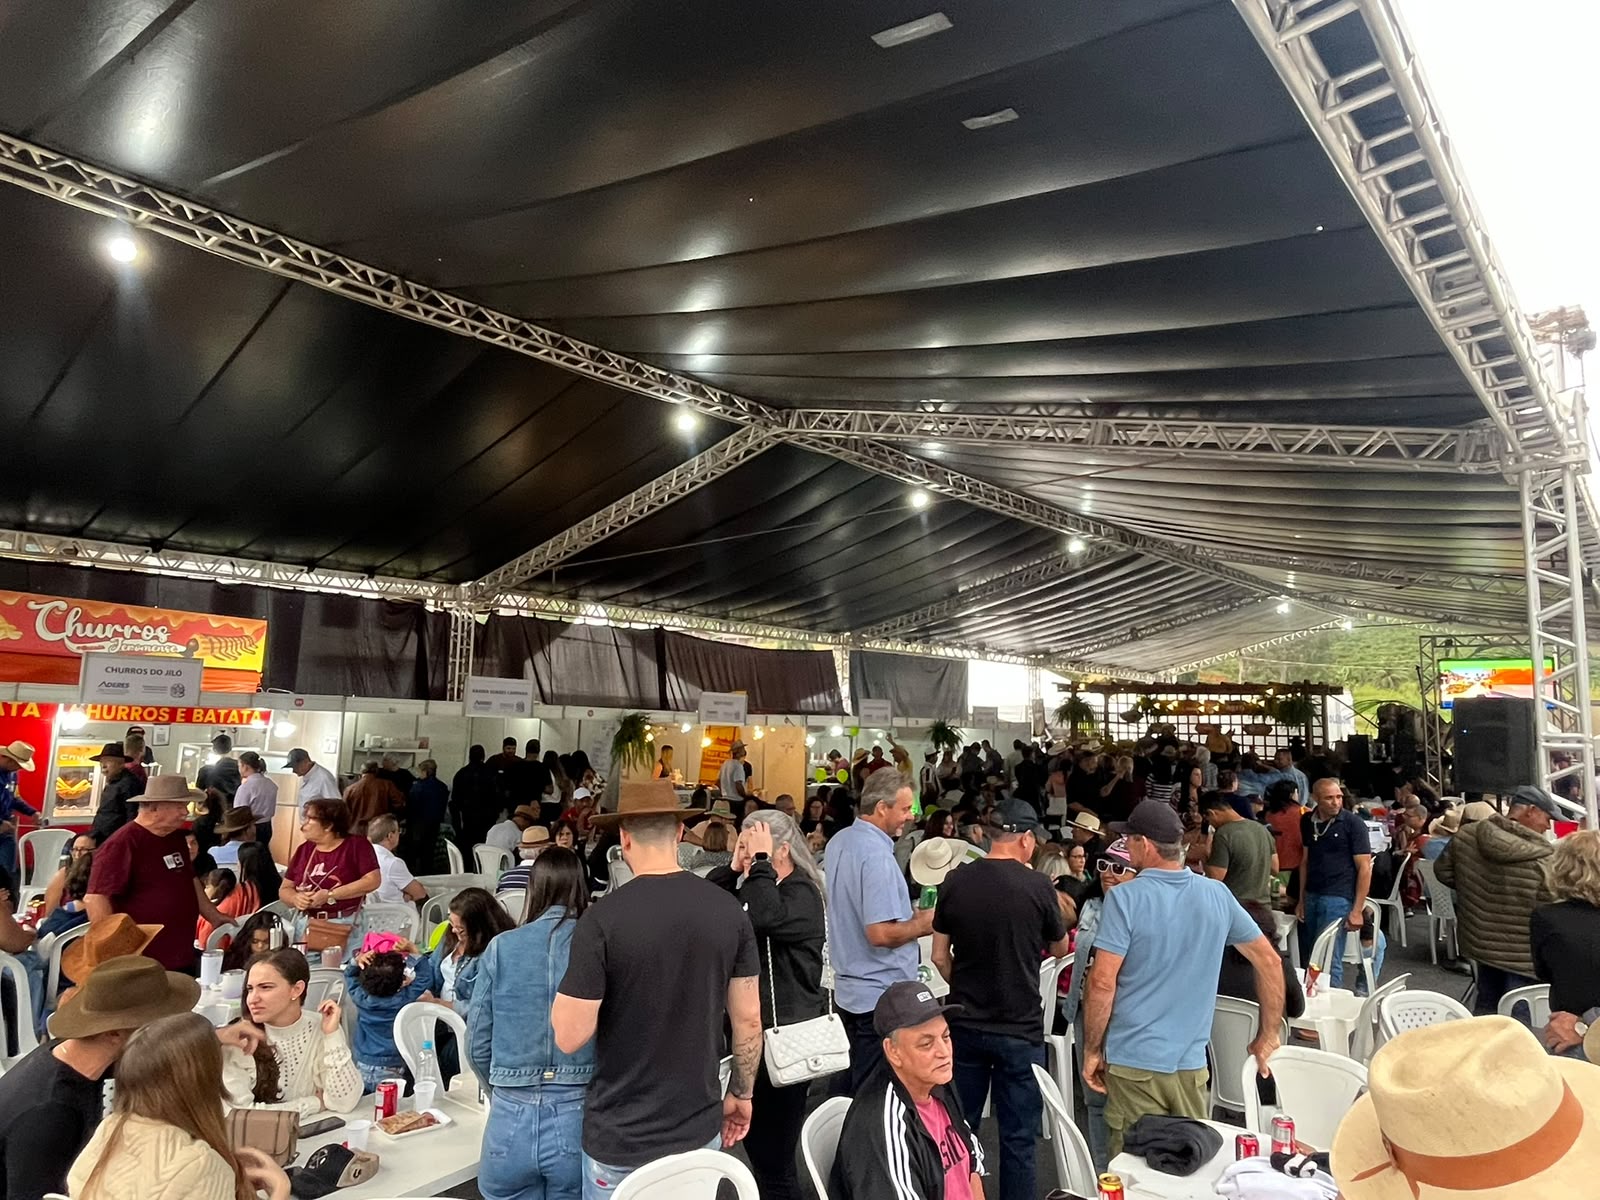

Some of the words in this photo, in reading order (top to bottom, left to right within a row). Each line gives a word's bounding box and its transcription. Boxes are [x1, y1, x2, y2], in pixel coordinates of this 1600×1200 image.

[27, 600, 171, 643] Churros
[105, 666, 148, 675] CHURROS
[150, 668, 163, 676] DO
[176, 708, 187, 722] E
[192, 709, 261, 725] BATATA
